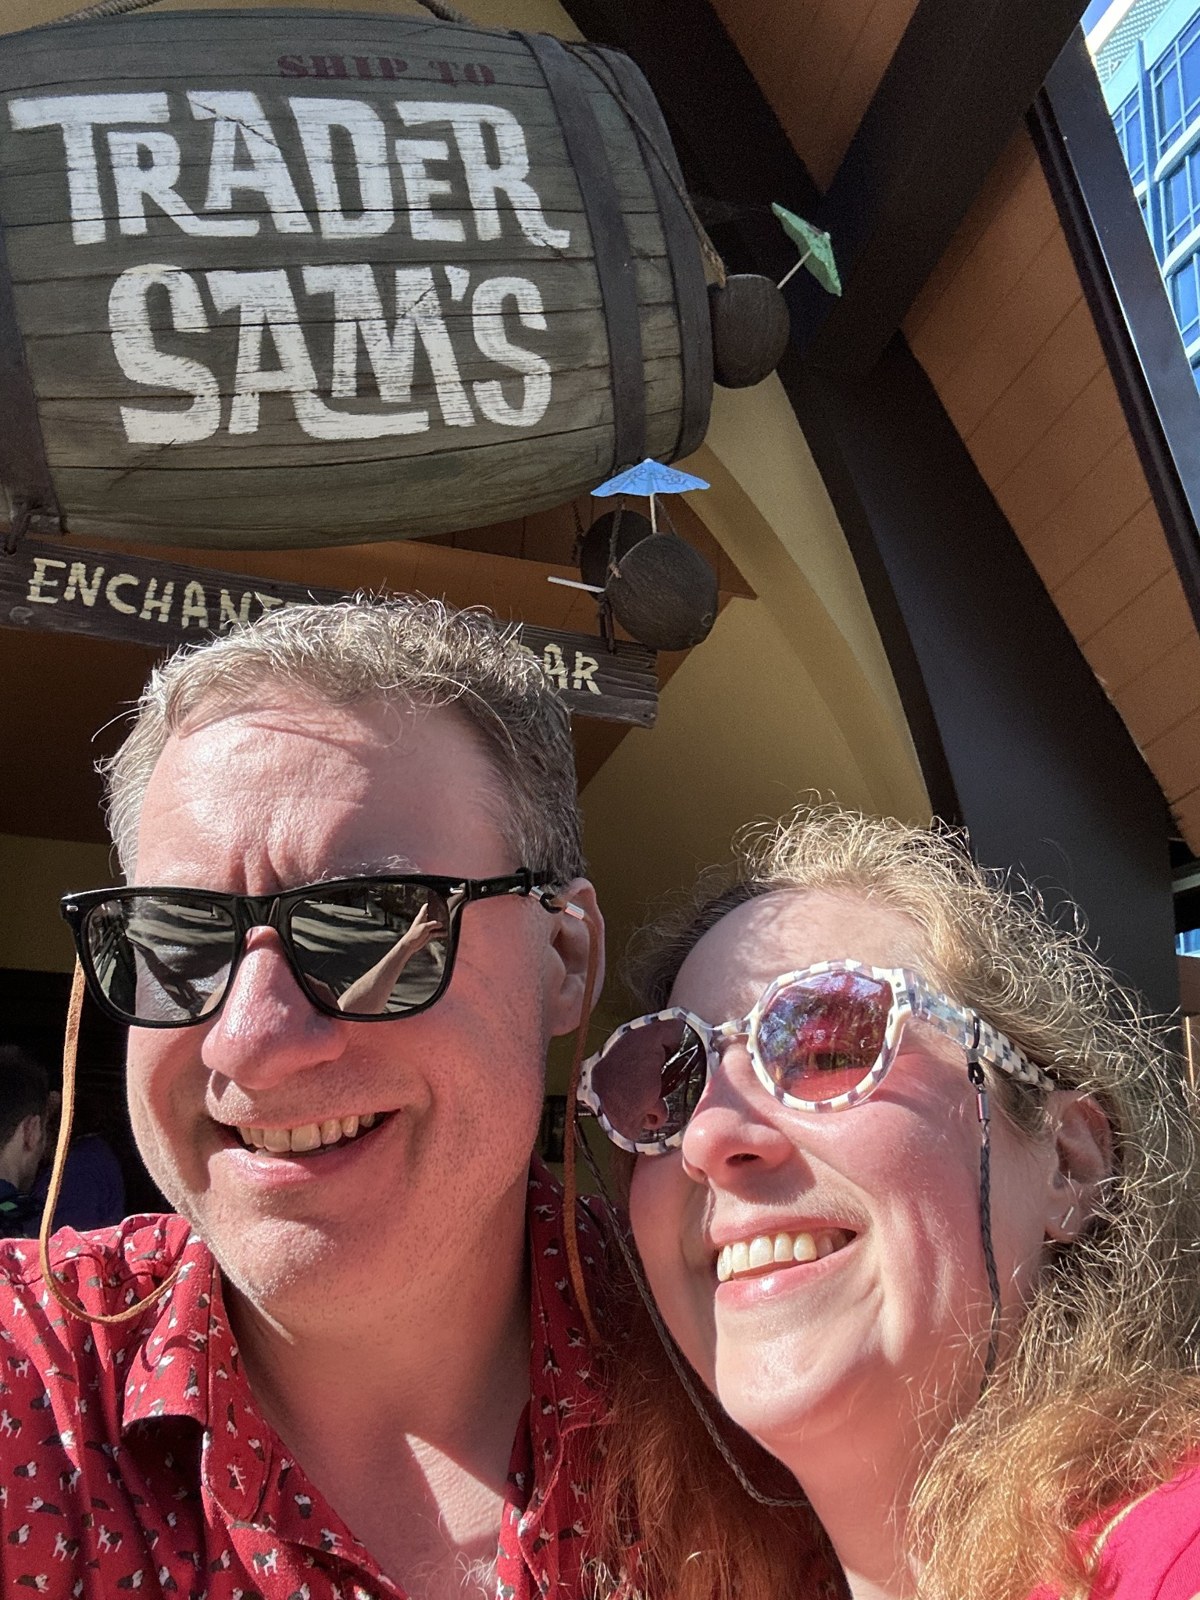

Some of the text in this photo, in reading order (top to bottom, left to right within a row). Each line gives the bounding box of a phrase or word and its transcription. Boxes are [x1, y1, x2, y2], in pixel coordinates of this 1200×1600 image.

[277, 54, 496, 88] SHIP TO
[10, 90, 570, 248] TRADER
[107, 263, 552, 444] SAM'S
[26, 557, 312, 631] ENCHANT
